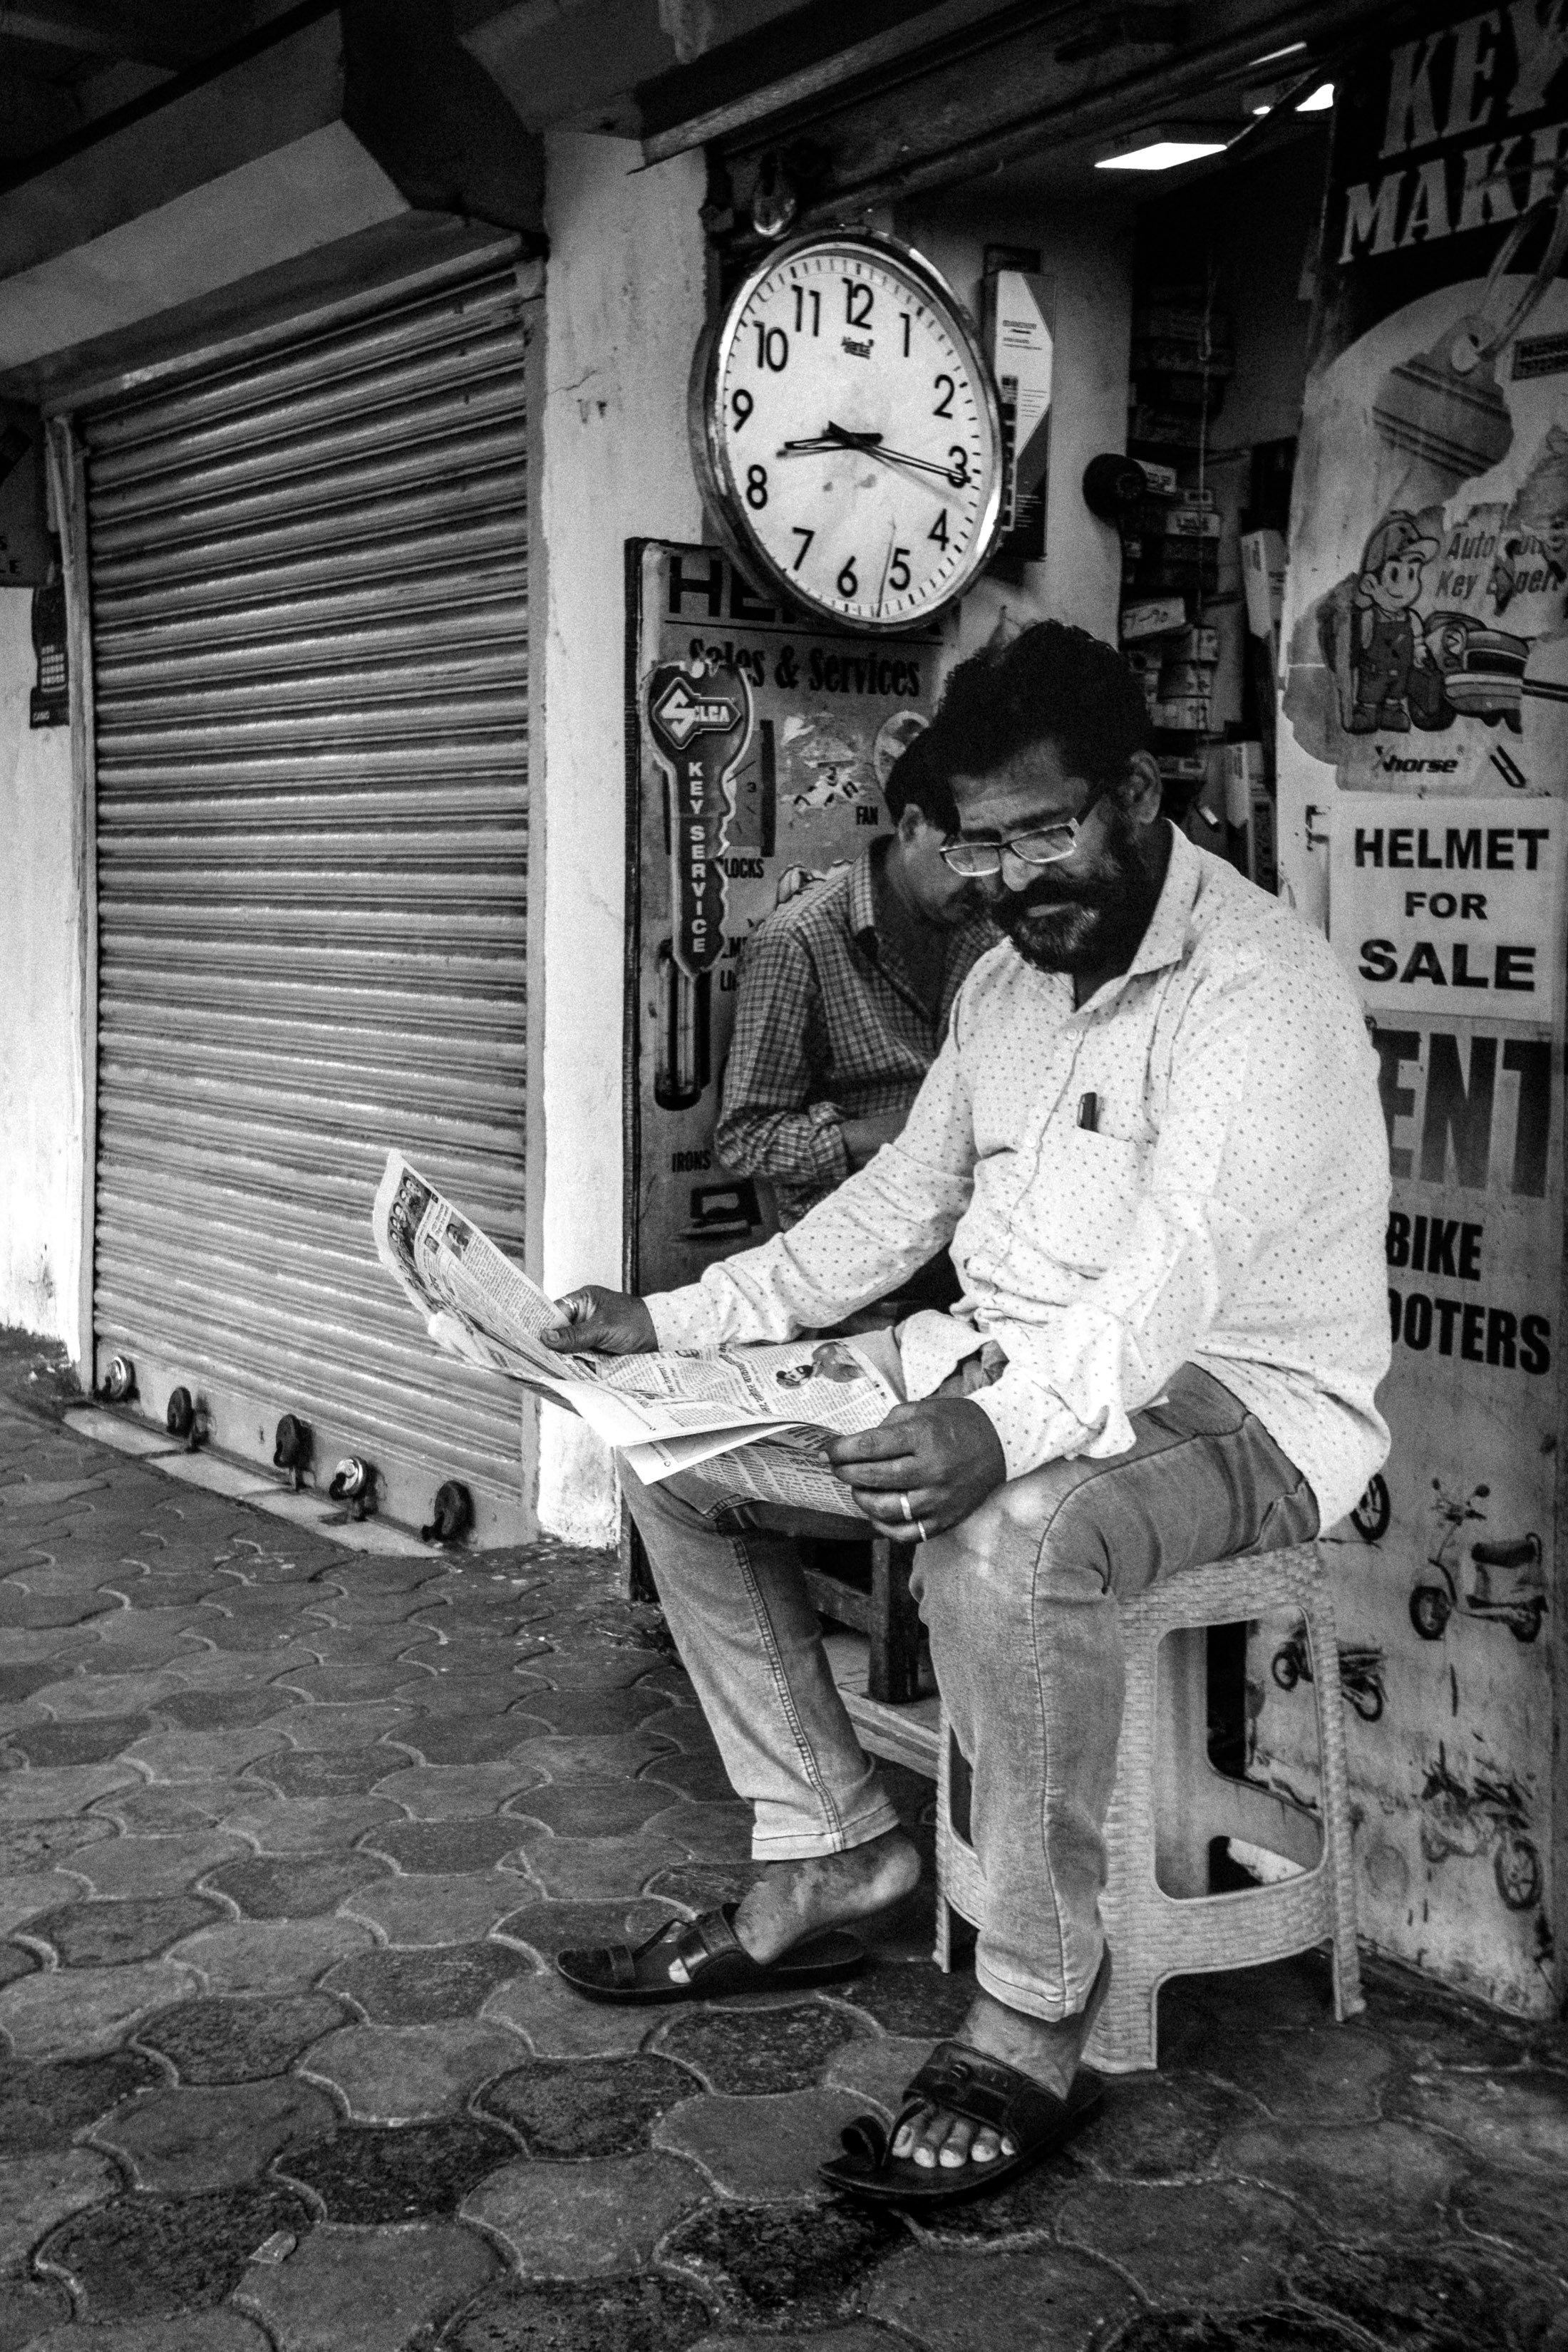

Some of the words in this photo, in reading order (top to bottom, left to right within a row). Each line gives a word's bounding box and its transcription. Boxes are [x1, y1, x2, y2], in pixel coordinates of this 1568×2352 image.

[791, 284, 820, 337] 11
[842, 277, 874, 331] 12
[753, 320, 788, 372] 10
[899, 312, 911, 357] 1
[731, 388, 754, 433] 9
[933, 374, 955, 420] 2
[746, 464, 768, 510] 8
[948, 445, 969, 488] 3
[792, 527, 815, 572] 7
[928, 508, 950, 552] 4
[837, 556, 857, 598] 6
[889, 547, 911, 590] 5
[1435, 570, 1479, 600] Key
[775, 645, 800, 690] &
[809, 646, 921, 698] Services
[688, 762, 704, 815] KEY
[856, 806, 878, 825] FAN
[1355, 827, 1550, 871] HELMET
[689, 825, 707, 954] SERVICE
[1404, 891, 1489, 920] FOR
[1358, 939, 1537, 992] SALE
[1371, 1028, 1552, 1199] ENT
[672, 1150, 711, 1173] IRONS
[1385, 1211, 1483, 1281] BIKE
